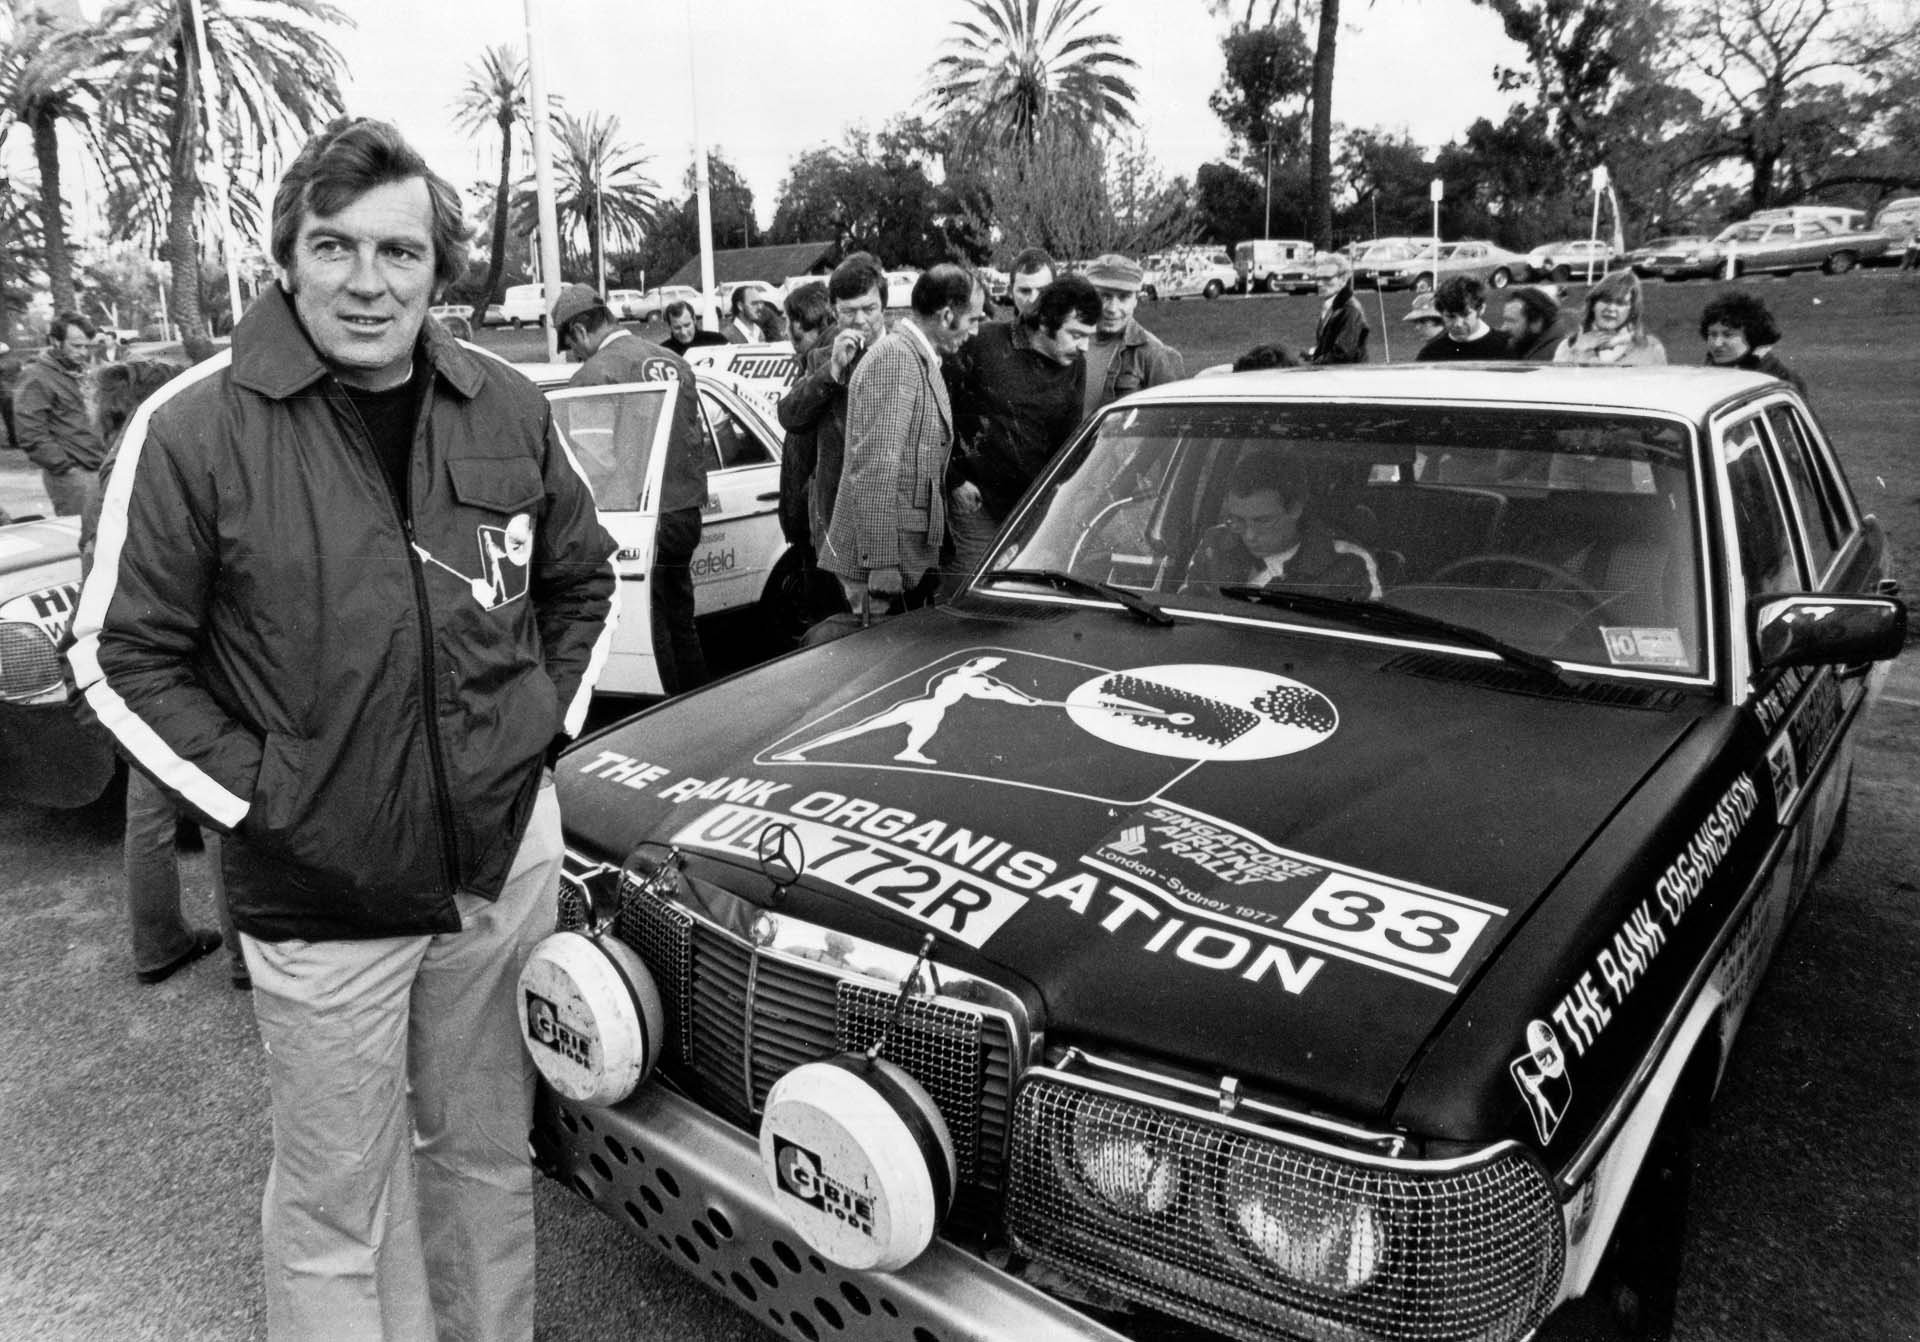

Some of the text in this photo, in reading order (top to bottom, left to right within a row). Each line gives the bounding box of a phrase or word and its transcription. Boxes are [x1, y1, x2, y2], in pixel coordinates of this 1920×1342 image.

[579, 751, 1327, 996] THE RANK ORGANISATION
[701, 810, 993, 934] ULL 772R
[1144, 808, 1323, 877] SINGAPORE
[1151, 825, 1297, 883] AIRLINES
[1159, 841, 1265, 885] RALLY
[1096, 847, 1157, 878] London
[1165, 877, 1231, 911] Sydney
[1234, 905, 1279, 923] 1977
[1552, 970, 1613, 1058] THE
[1596, 898, 1667, 1005] RANK
[1656, 770, 1759, 927] ORGANISATION
[1311, 889, 1461, 956] 33
